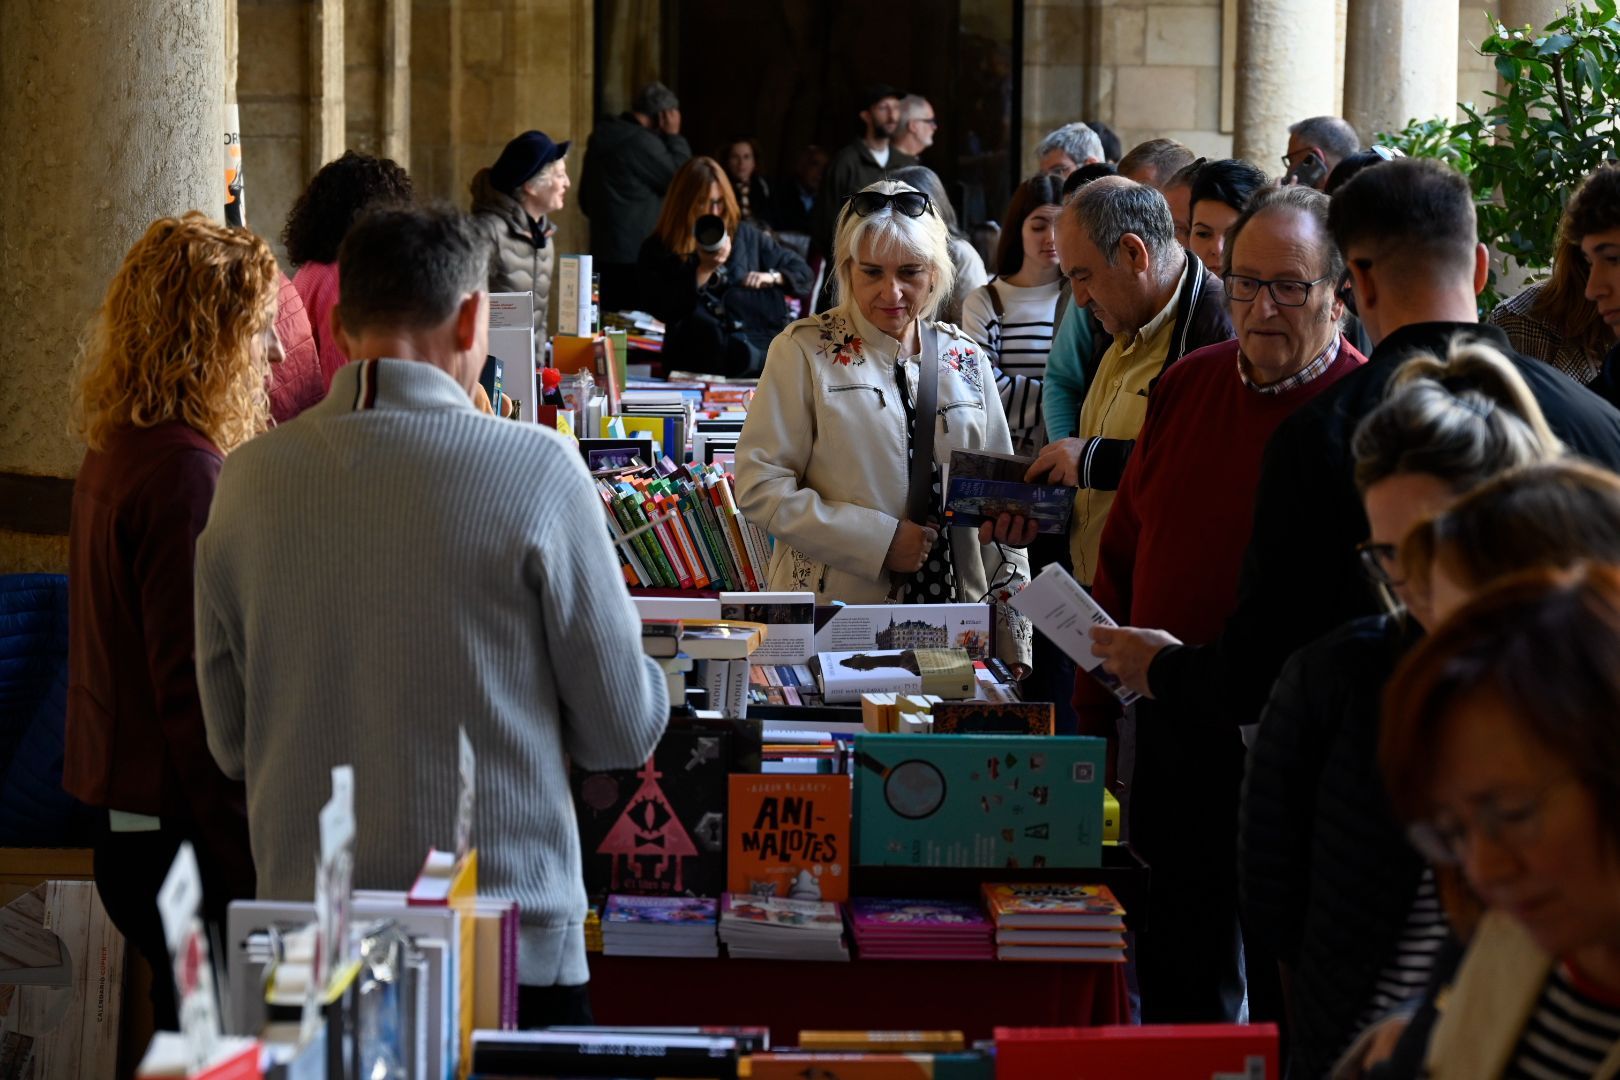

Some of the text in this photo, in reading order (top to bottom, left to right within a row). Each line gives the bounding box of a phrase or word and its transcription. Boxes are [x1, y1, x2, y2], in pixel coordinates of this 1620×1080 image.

[712, 673, 722, 707] PADILLA
[734, 673, 743, 706] PADILLA
[753, 796, 826, 830] ANI-
[741, 829, 837, 863] MALOTES
[97, 976, 106, 1023] CALENDARIO
